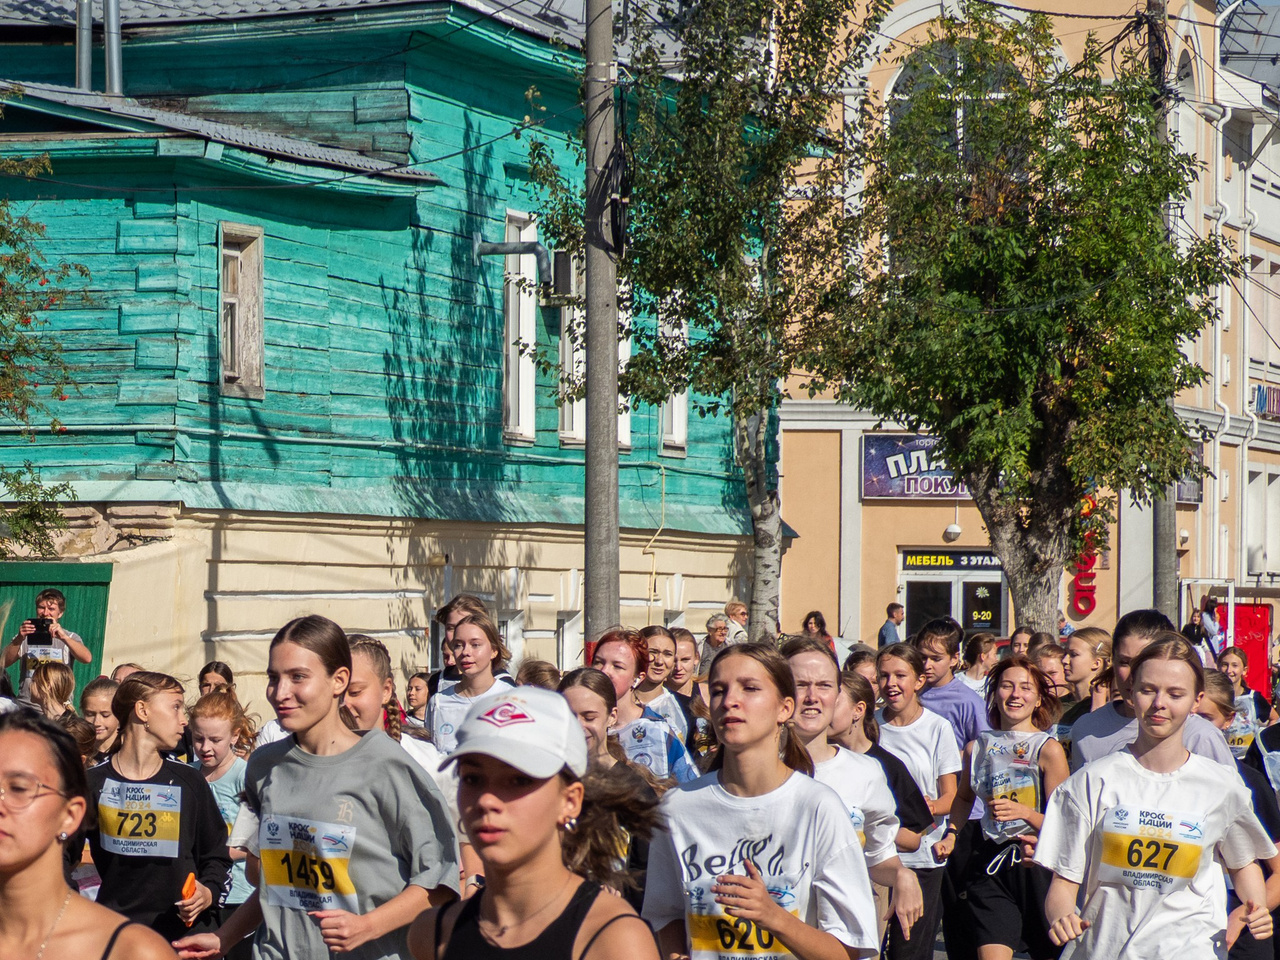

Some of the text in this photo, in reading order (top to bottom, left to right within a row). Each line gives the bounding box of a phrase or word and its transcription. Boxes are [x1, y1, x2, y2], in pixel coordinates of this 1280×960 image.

[906, 555, 1002, 566] МЕБЕЛЬ 3 ЭТАЖ
[972, 610, 992, 621] 9-20
[125, 801, 151, 810] 2024
[1140, 810, 1166, 821] КРОСС
[117, 812, 157, 838] 723
[1139, 818, 1172, 829] НАЦИИ
[1139, 826, 1172, 839] 2024
[112, 839, 158, 848] ВЛАДИМИРСКАЯ
[1127, 838, 1179, 871] 627
[281, 853, 336, 890] 1459
[1122, 870, 1173, 885] ВЛАДИМИРСКАЯ
[1132, 880, 1162, 889] ОБЛАСТЬ
[716, 915, 775, 951] 620
